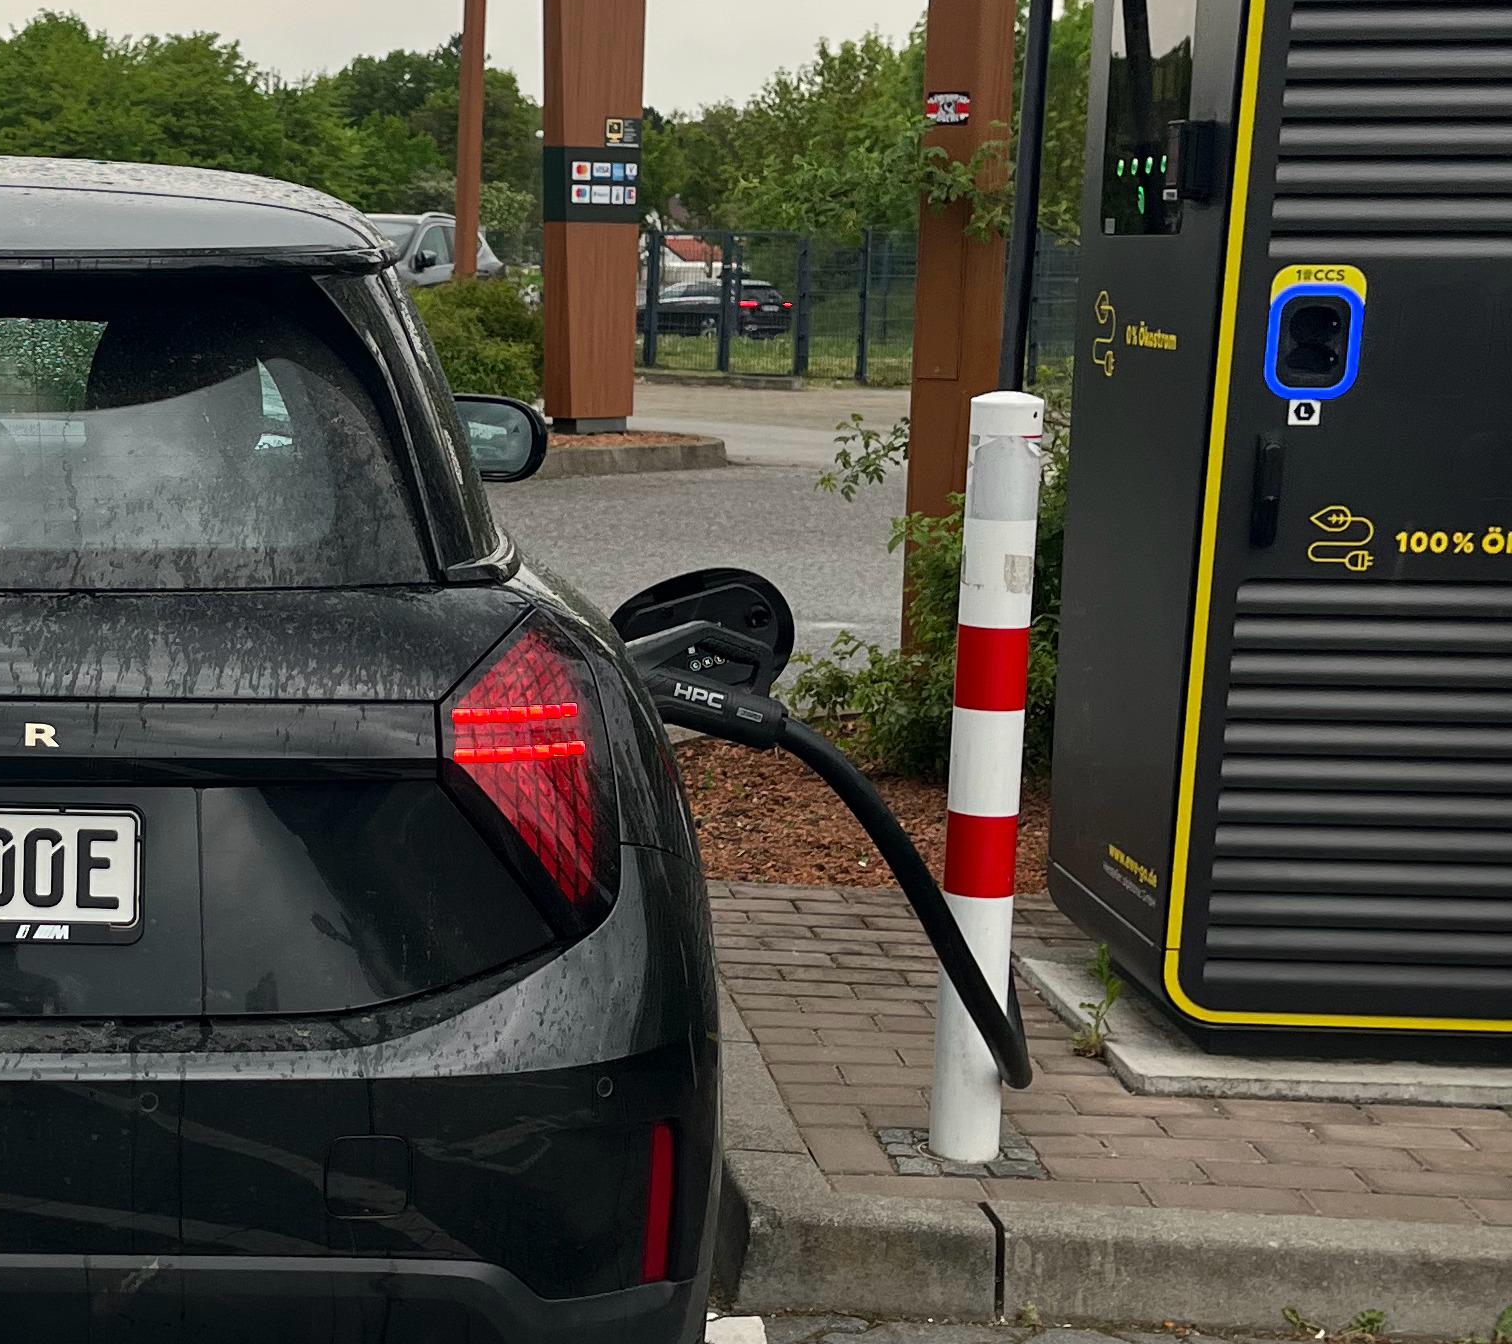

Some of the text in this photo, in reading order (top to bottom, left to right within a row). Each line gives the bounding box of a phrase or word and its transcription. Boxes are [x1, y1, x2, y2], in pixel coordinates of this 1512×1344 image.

[1296, 269, 1345, 282] 1 CCS
[674, 682, 725, 710] HPC
